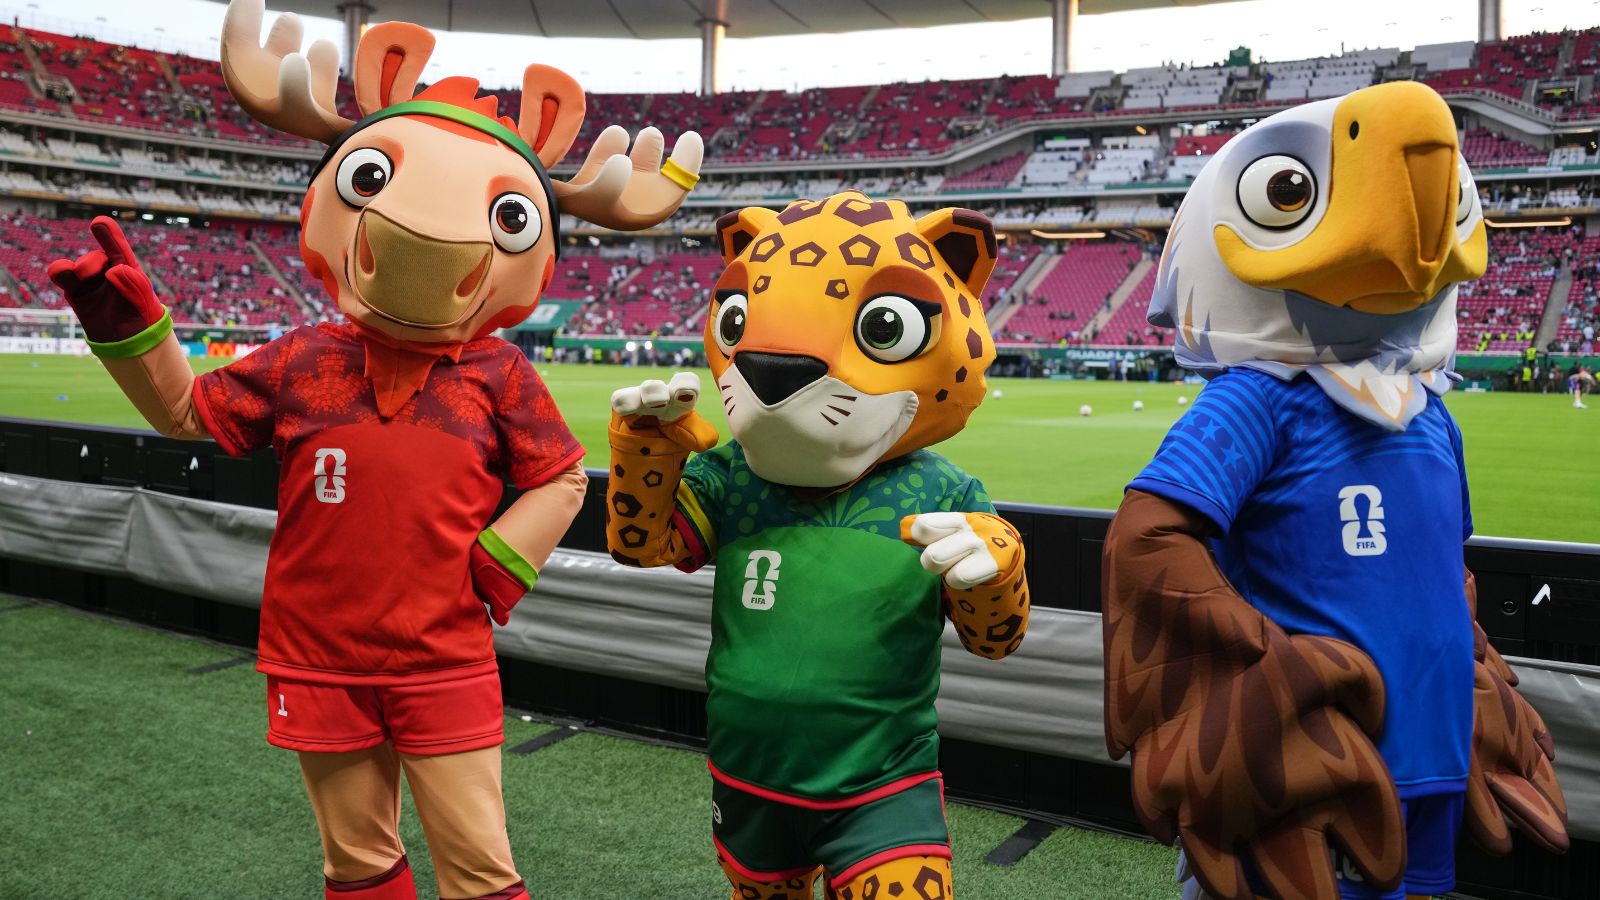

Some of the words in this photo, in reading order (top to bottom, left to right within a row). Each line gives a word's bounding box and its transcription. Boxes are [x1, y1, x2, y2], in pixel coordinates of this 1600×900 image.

[323, 491, 338, 499] FIFA
[1356, 541, 1377, 550] FIFA
[750, 597, 766, 605] FIFA
[277, 694, 288, 717] 1
